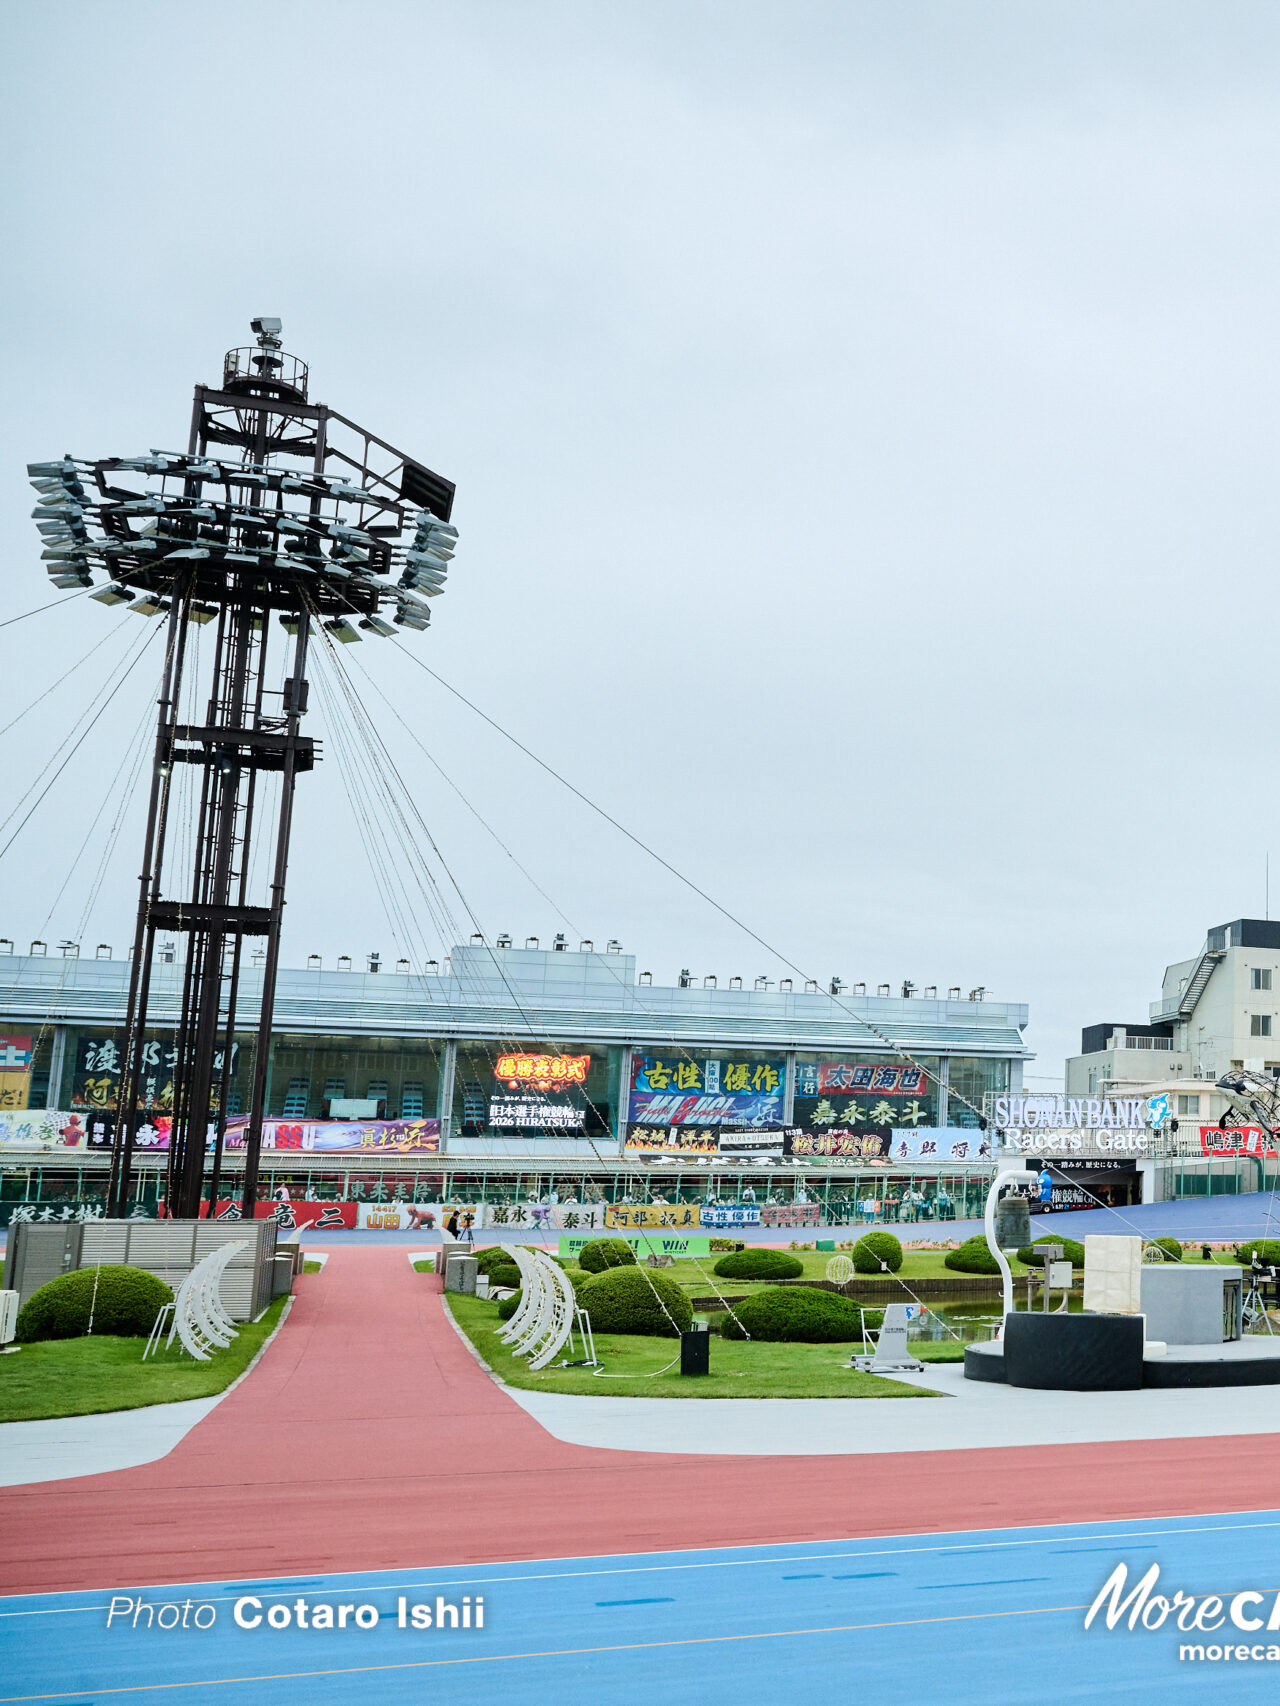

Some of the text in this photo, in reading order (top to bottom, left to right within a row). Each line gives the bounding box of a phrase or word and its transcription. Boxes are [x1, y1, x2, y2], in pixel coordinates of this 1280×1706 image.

[499, 1057, 584, 1079] 優勝表彰式
[644, 1061, 702, 1091] 古性
[723, 1062, 781, 1092] 優作
[825, 1064, 923, 1089] 太田海也
[489, 1117, 514, 1126] 2026
[810, 1099, 928, 1126] 嘉永泰斗
[995, 1097, 1146, 1129] SHONAN BANK
[1095, 1128, 1149, 1150] Gate
[366, 1214, 401, 1229] 山田
[662, 1240, 689, 1251] WIN
